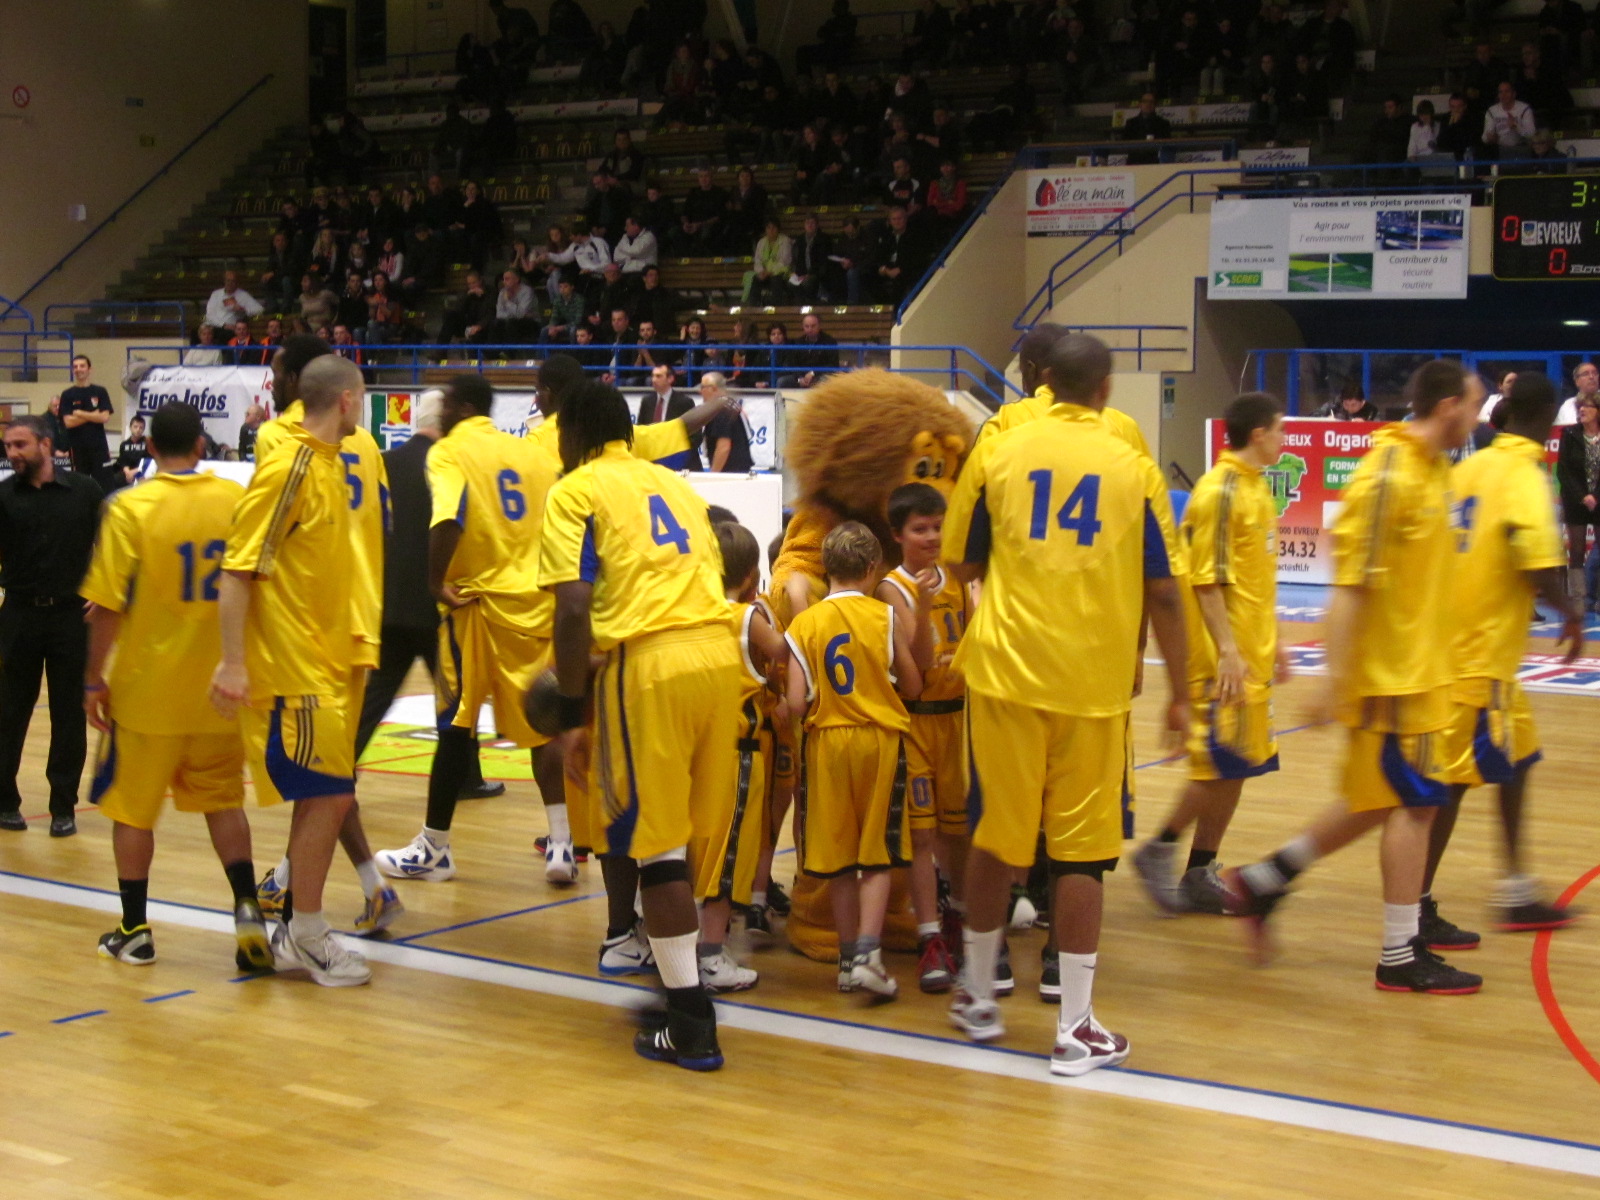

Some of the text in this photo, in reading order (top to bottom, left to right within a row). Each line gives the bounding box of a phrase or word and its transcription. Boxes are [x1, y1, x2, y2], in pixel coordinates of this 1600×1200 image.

[1072, 188, 1088, 201] en
[1091, 185, 1125, 201] main
[1293, 197, 1462, 209] Vos routes et vos projets prennent vie
[1314, 221, 1351, 231] Agir pour
[1501, 215, 1582, 245] 0 EVREUX
[1388, 254, 1448, 265] Contribuer à la
[1549, 248, 1567, 275] 0
[1401, 266, 1434, 277] sécurité
[1231, 273, 1260, 285] SCREG
[1401, 279, 1434, 290] routière
[1281, 434, 1313, 446] REUX
[1326, 473, 1340, 484] EN
[496, 468, 525, 521] 6
[1028, 469, 1102, 546] 14
[647, 494, 692, 555] 4
[1293, 527, 1320, 536] EVREUX
[176, 539, 227, 602] 12
[825, 633, 856, 696] 6
